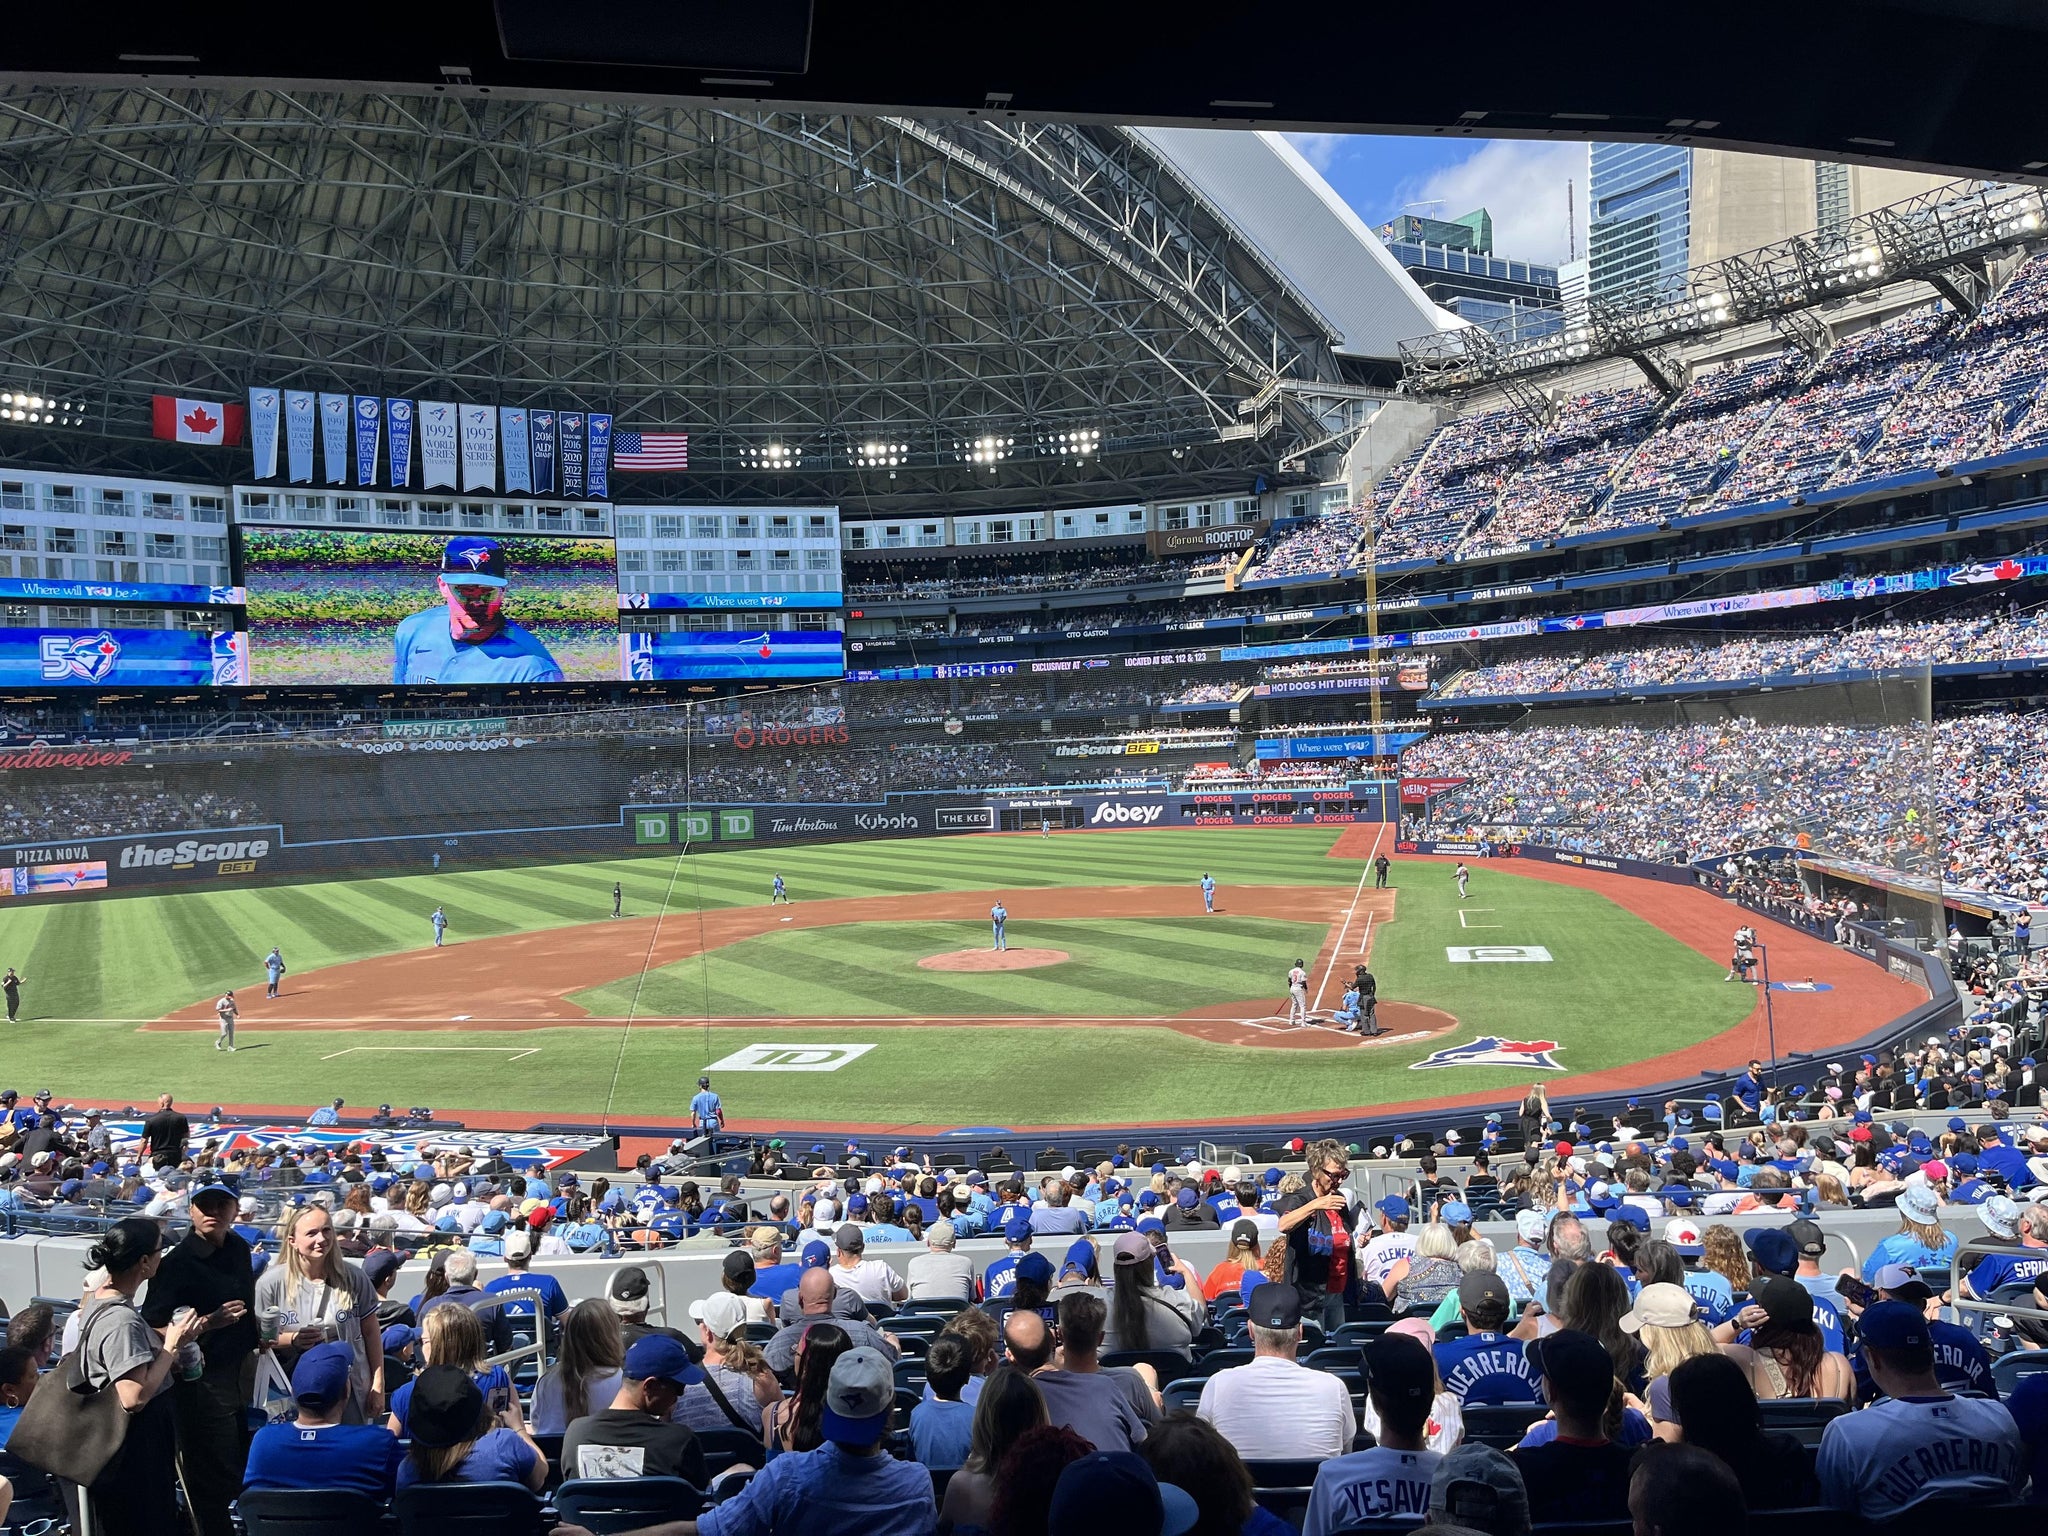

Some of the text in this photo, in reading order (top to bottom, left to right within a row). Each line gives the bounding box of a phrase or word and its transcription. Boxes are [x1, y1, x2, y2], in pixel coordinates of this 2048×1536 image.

[292, 415, 313, 424] 1989
[327, 418, 345, 426] 1991
[426, 424, 454, 438] 1992
[466, 428, 494, 440] 1993
[535, 432, 552, 441] 2016
[426, 440, 456, 450] WORLD
[564, 441, 581, 449] 2016
[592, 436, 608, 445] 2025
[465, 442, 495, 452] WORLD
[426, 449, 456, 459] SERIES
[466, 452, 495, 461] SERIES
[564, 453, 582, 462] 2020
[564, 466, 582, 474] 2022
[565, 479, 582, 488] 2023
[1166, 535, 1204, 549] Corona
[1206, 529, 1254, 545] ROOFTOP
[1464, 544, 1530, 560] JACKIE ROBINSON
[22, 584, 61, 595] Where
[64, 585, 82, 596] will
[1472, 586, 1533, 600] JOSÉ BAUTISTA
[705, 596, 735, 606] Where
[737, 598, 759, 606] were
[1383, 600, 1420, 610] HALLADAY
[1664, 606, 1692, 618] Where
[1694, 602, 1708, 614] will
[1732, 598, 1750, 610] be?
[1265, 614, 1281, 622] PAUL
[1179, 622, 1204, 630] GILLICK
[1083, 629, 1109, 638] GASTON
[1423, 624, 1527, 642] TORONTO BLUE JAYS
[979, 635, 1014, 644] DAVE STIEB
[1124, 657, 1151, 666] LOCATED
[1152, 656, 1160, 665] AT
[1161, 655, 1174, 664] SEC.
[1175, 655, 1186, 664] 112
[1195, 653, 1207, 662] 123
[1032, 661, 1080, 672] EXCLUSIVELY AT
[1271, 677, 1390, 692] HOT DOGS HIT DIFFERENT
[386, 723, 456, 738] WESTJET
[476, 722, 506, 730] FLIGHT
[761, 725, 850, 746] ROGERS
[1055, 744, 1122, 756] theScore
[1127, 743, 1157, 753] BET
[1296, 743, 1321, 753] Where
[0, 746, 133, 769] udweiser
[1402, 784, 1428, 796] HEINZ
[1261, 793, 1292, 801] ROGERS
[1323, 792, 1354, 800] ROGERS
[943, 814, 987, 823] THE KEG
[1091, 801, 1164, 824] Sobeys
[640, 819, 666, 838] TD
[724, 815, 750, 834] TD
[771, 817, 838, 832] Tim Hortons
[855, 812, 918, 829] Kubota
[1397, 841, 1418, 852] HEINZ
[16, 846, 89, 864] PIZZA NOVA
[120, 840, 269, 869] theScore
[221, 862, 254, 873] BET
[1218, 1199, 1239, 1211] BICHE
[1378, 1248, 1415, 1264] CLEMEN
[2014, 1260, 2048, 1278] SPRIN
[1812, 1306, 1834, 1330] ZKI
[1934, 1344, 1984, 1385] ERO JR
[1876, 1439, 1999, 1506] GUERRERO
